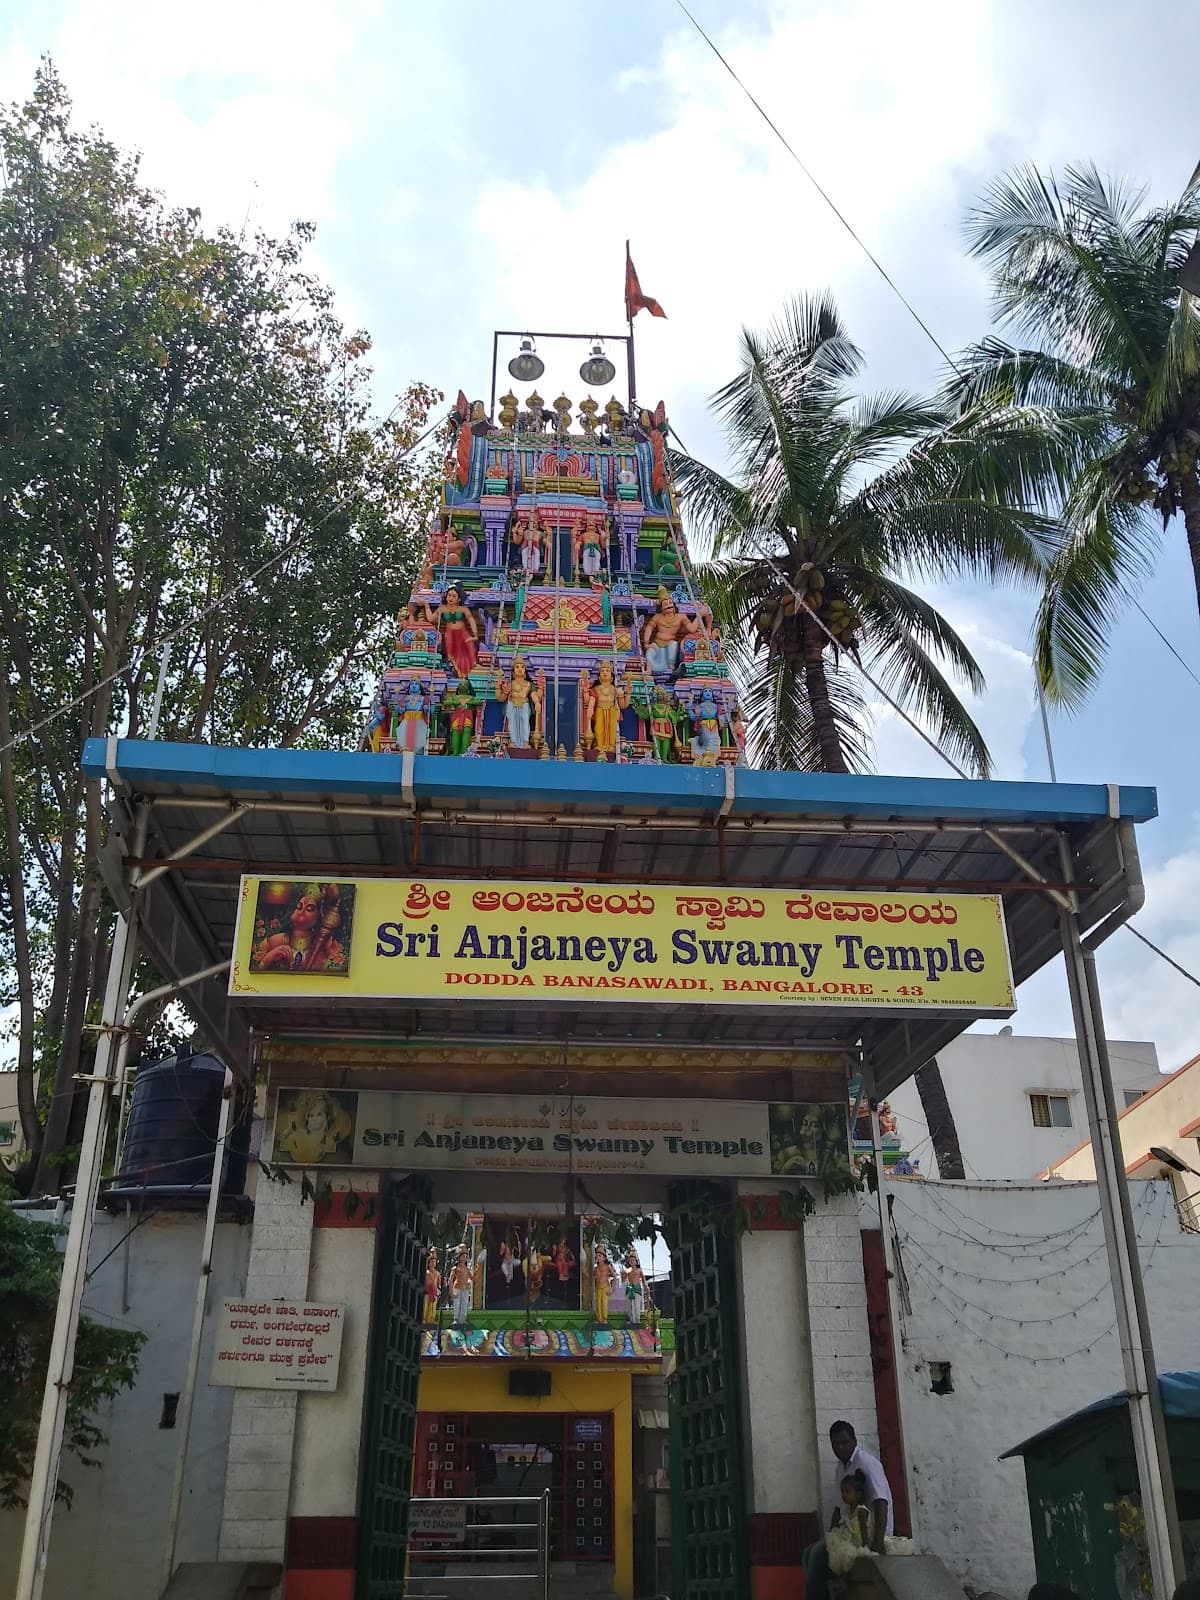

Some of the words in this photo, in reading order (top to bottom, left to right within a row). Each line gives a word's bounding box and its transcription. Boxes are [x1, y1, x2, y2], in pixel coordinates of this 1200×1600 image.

[402, 883, 451, 919] ಶ್ರೀ
[472, 886, 655, 915] ಆಂಜನೇಯ
[675, 895, 765, 930] ಸ್ವಾಮಿ
[785, 893, 958, 925] ದೇವಾಲಯ
[375, 921, 441, 958] Sri
[454, 925, 658, 972] Anjaneya
[671, 928, 823, 978] Swamy
[835, 934, 985, 982] Temple
[444, 972, 535, 986] DODDA
[543, 975, 713, 992] BANASAWADI,
[722, 979, 873, 995] BANGALORE
[897, 985, 923, 996] 43
[362, 1128, 405, 1147] Sri
[414, 1130, 545, 1153] Anjaneya
[552, 1133, 655, 1156] Swamy
[664, 1136, 764, 1157] Temple
